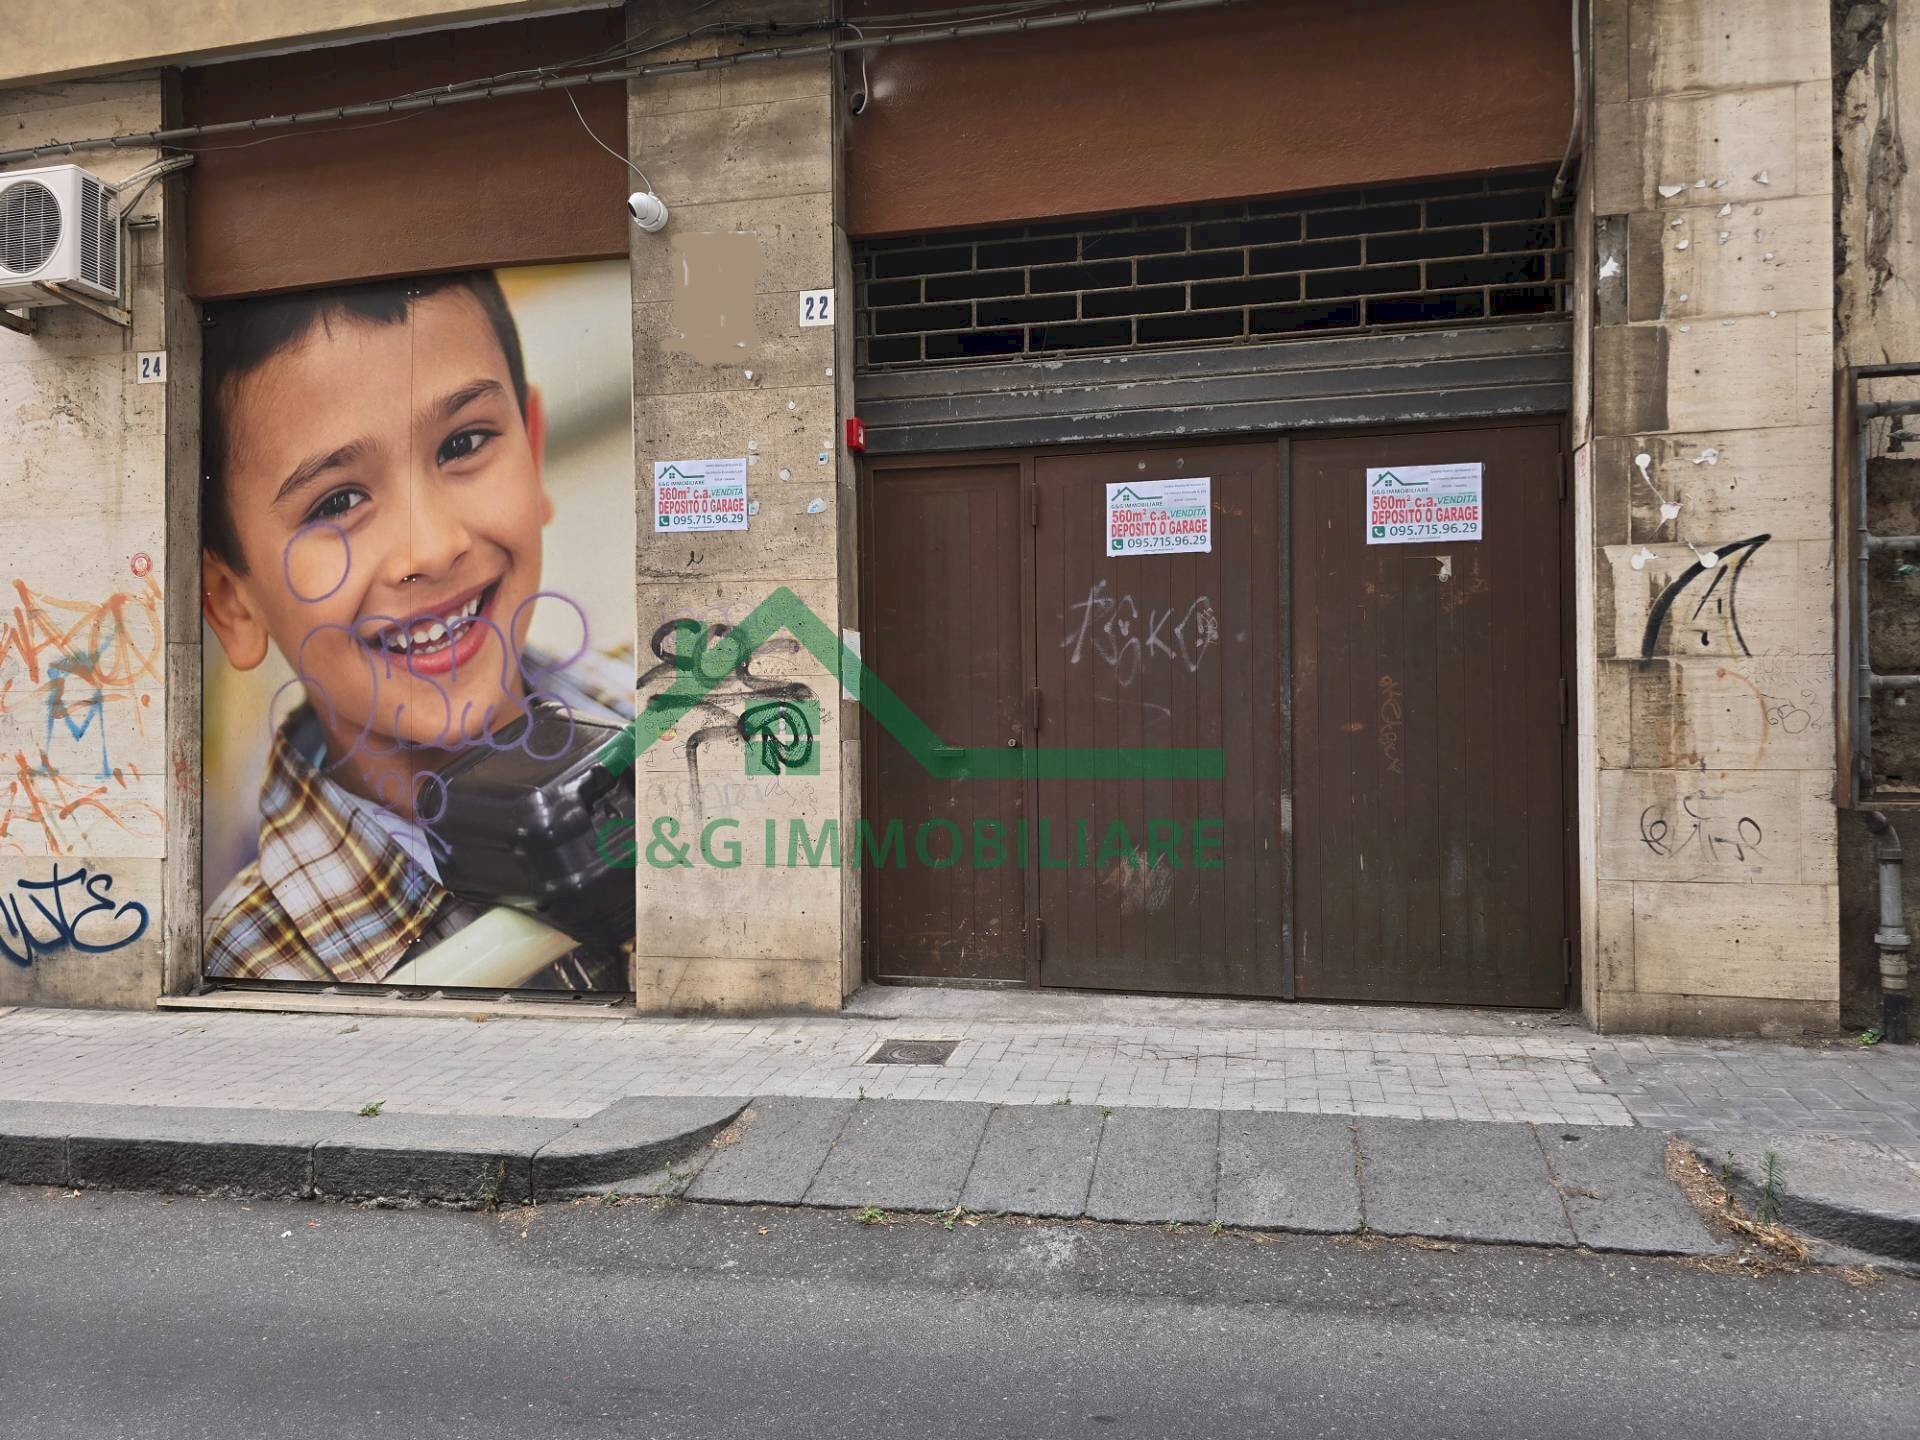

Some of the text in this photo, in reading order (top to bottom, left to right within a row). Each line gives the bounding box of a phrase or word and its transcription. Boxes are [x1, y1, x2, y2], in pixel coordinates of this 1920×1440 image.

[806, 296, 828, 320] 22
[142, 357, 161, 378] 24
[693, 489, 711, 499] c.a.
[711, 488, 743, 496] VENDITA
[658, 498, 744, 514] DEPOSITO O GARAGE
[1415, 497, 1437, 508] c.a.
[1437, 495, 1477, 504] VENDITA
[673, 514, 743, 525] 095.715.96.29
[1150, 511, 1170, 521] c.a.
[1170, 509, 1206, 518] VENDITA
[1371, 506, 1478, 525] DEPOSITO O GARAGE
[1111, 519, 1207, 538] DEPOSITO O GARAGE
[1390, 523, 1477, 536] 095.715.96.29
[1127, 535, 1206, 548] 095.715.96.29
